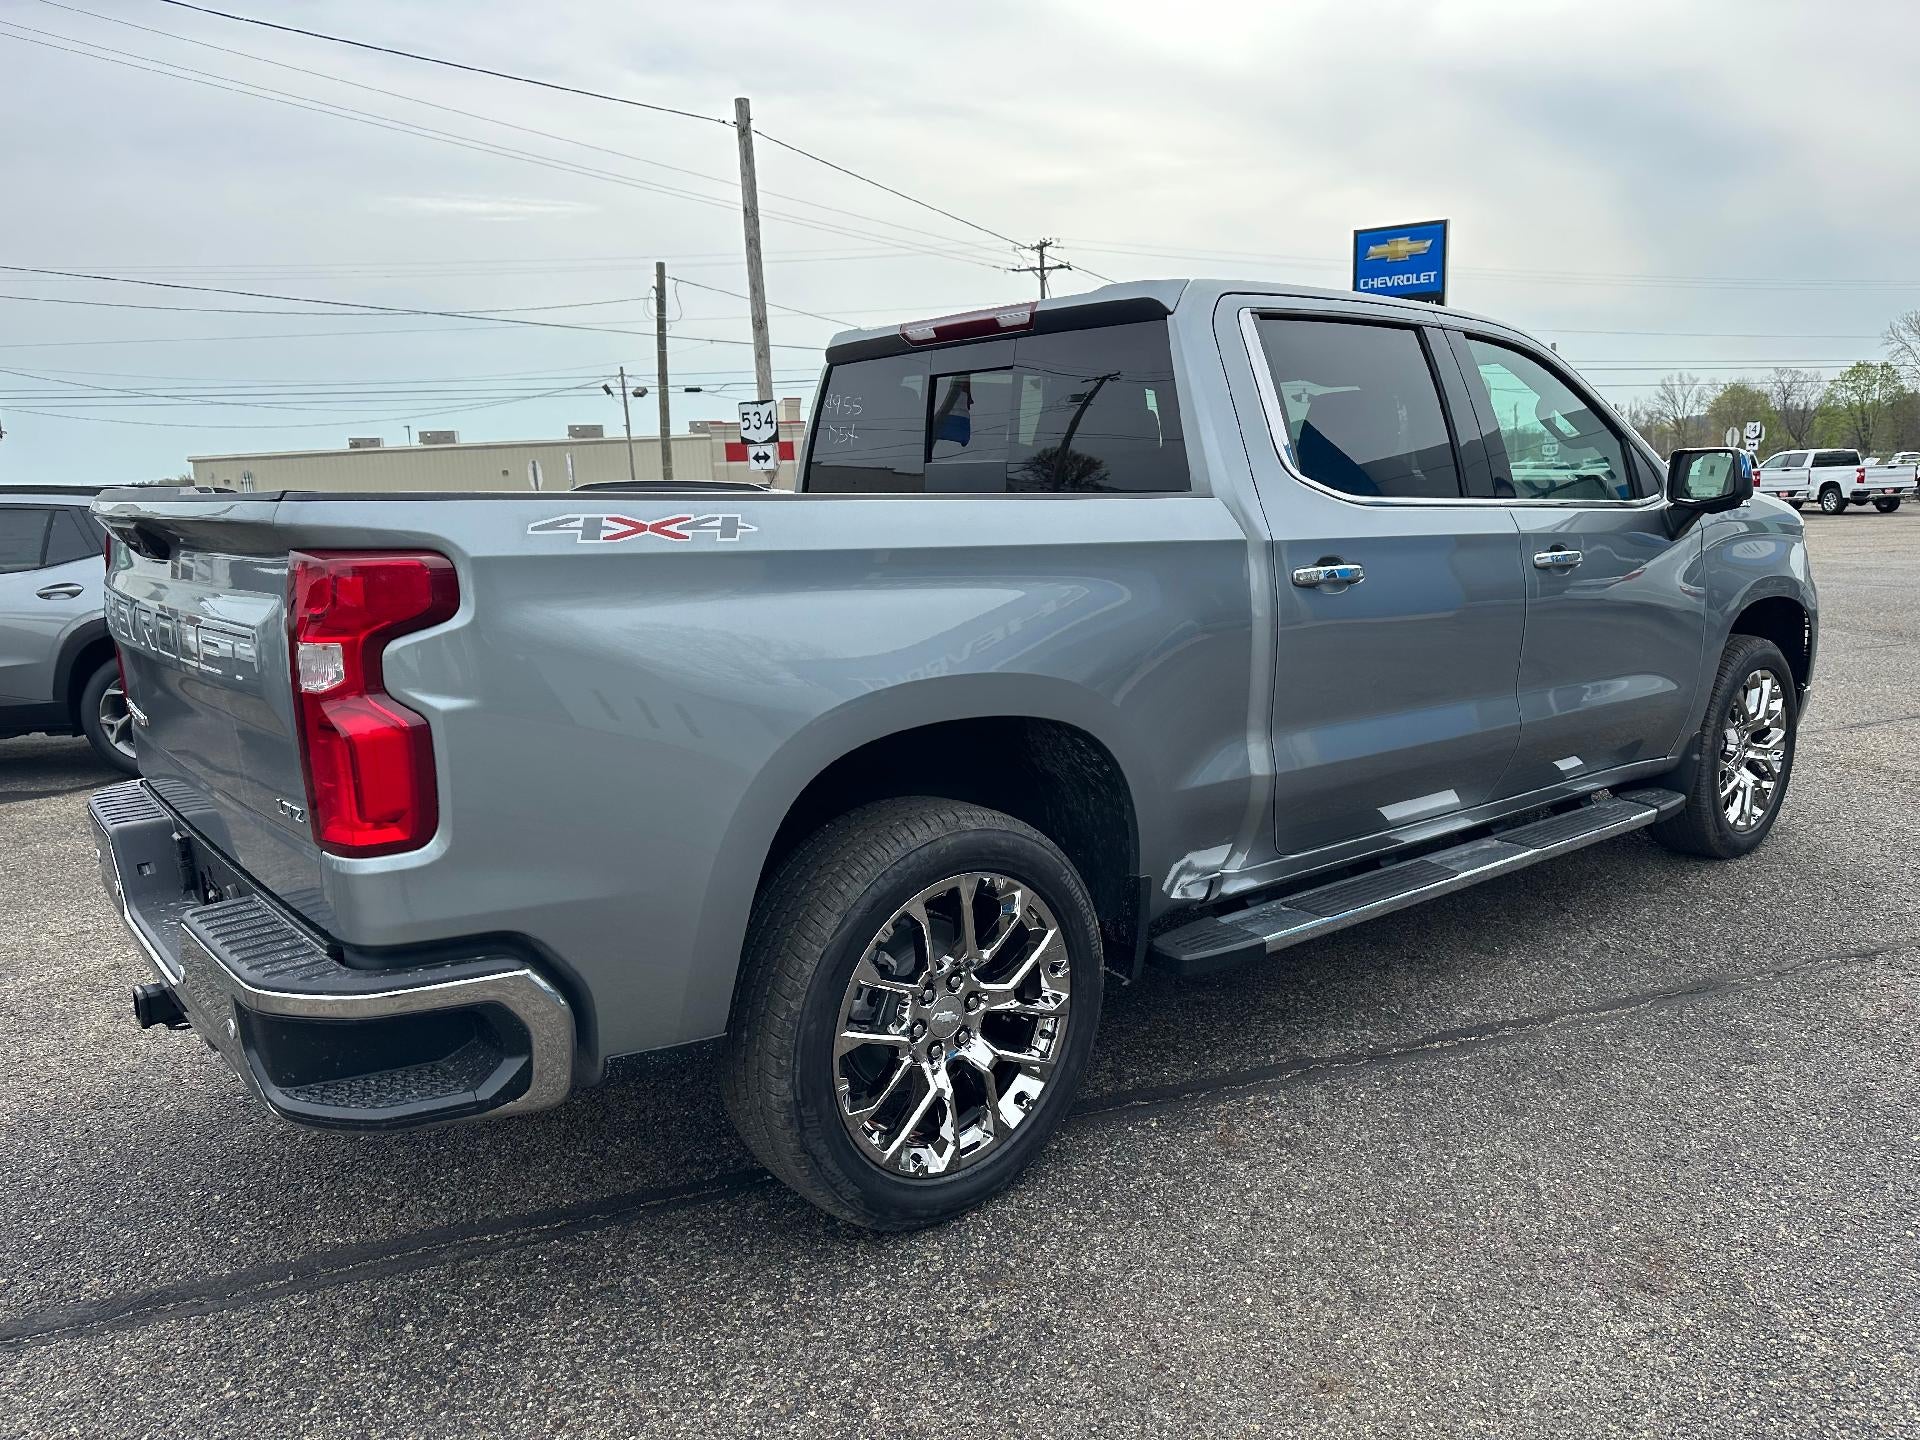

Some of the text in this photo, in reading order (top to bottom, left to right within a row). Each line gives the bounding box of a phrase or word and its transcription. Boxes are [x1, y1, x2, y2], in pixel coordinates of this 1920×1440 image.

[1360, 271, 1437, 290] CHEVROLET
[741, 409, 775, 431] 534
[1748, 424, 1757, 435] 14
